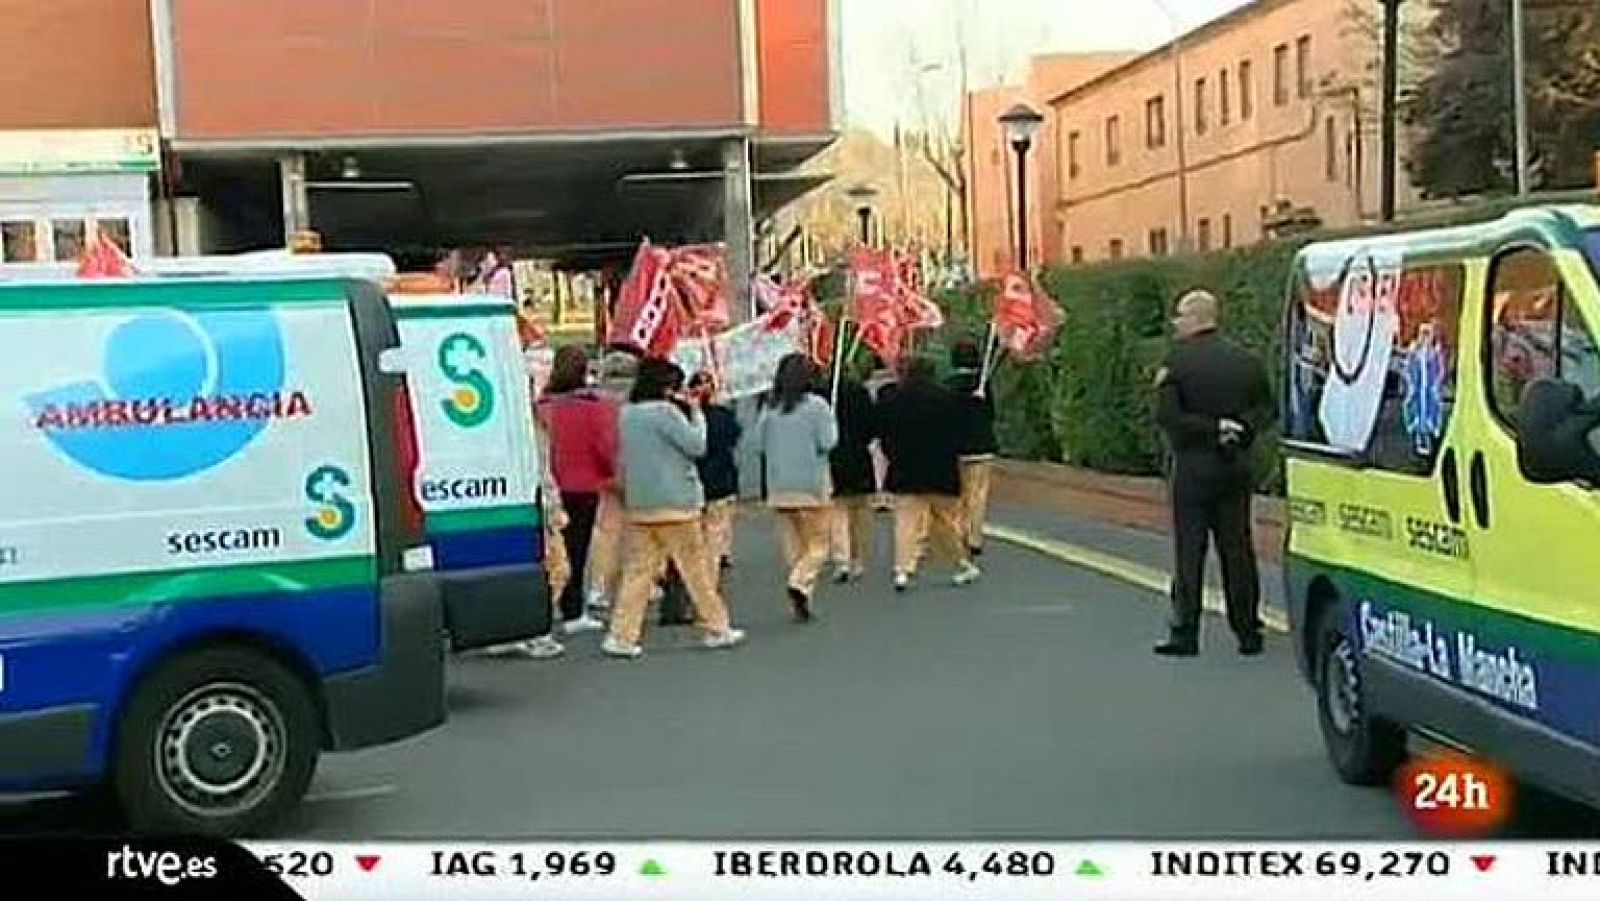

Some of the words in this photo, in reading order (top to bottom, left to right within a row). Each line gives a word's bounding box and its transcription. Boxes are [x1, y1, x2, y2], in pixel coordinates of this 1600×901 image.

[35, 390, 312, 428] AMBULANCIA
[421, 476, 508, 501] escam
[167, 526, 281, 554] sescam
